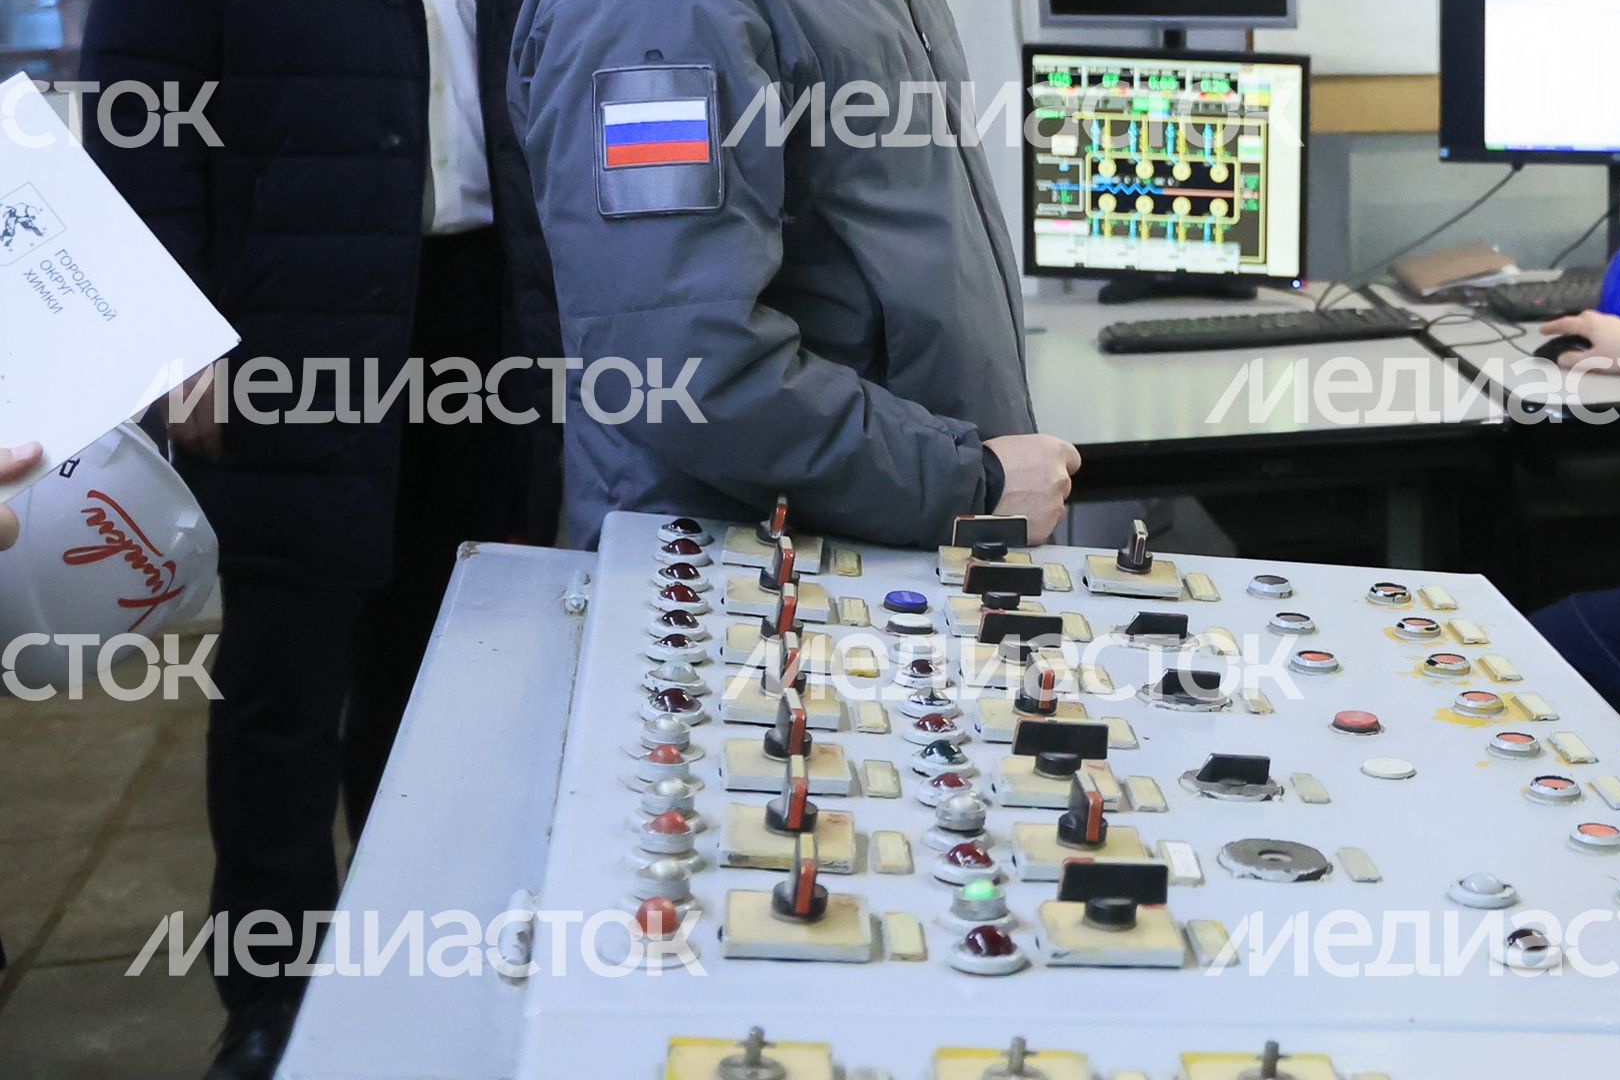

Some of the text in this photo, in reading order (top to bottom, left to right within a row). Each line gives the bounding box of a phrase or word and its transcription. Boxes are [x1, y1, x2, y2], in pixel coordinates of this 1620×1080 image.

[22, 268, 64, 314] ХИМКИ
[39, 259, 76, 296] ОКРУГ
[54, 249, 118, 322] ГОРОДСКОЙ
